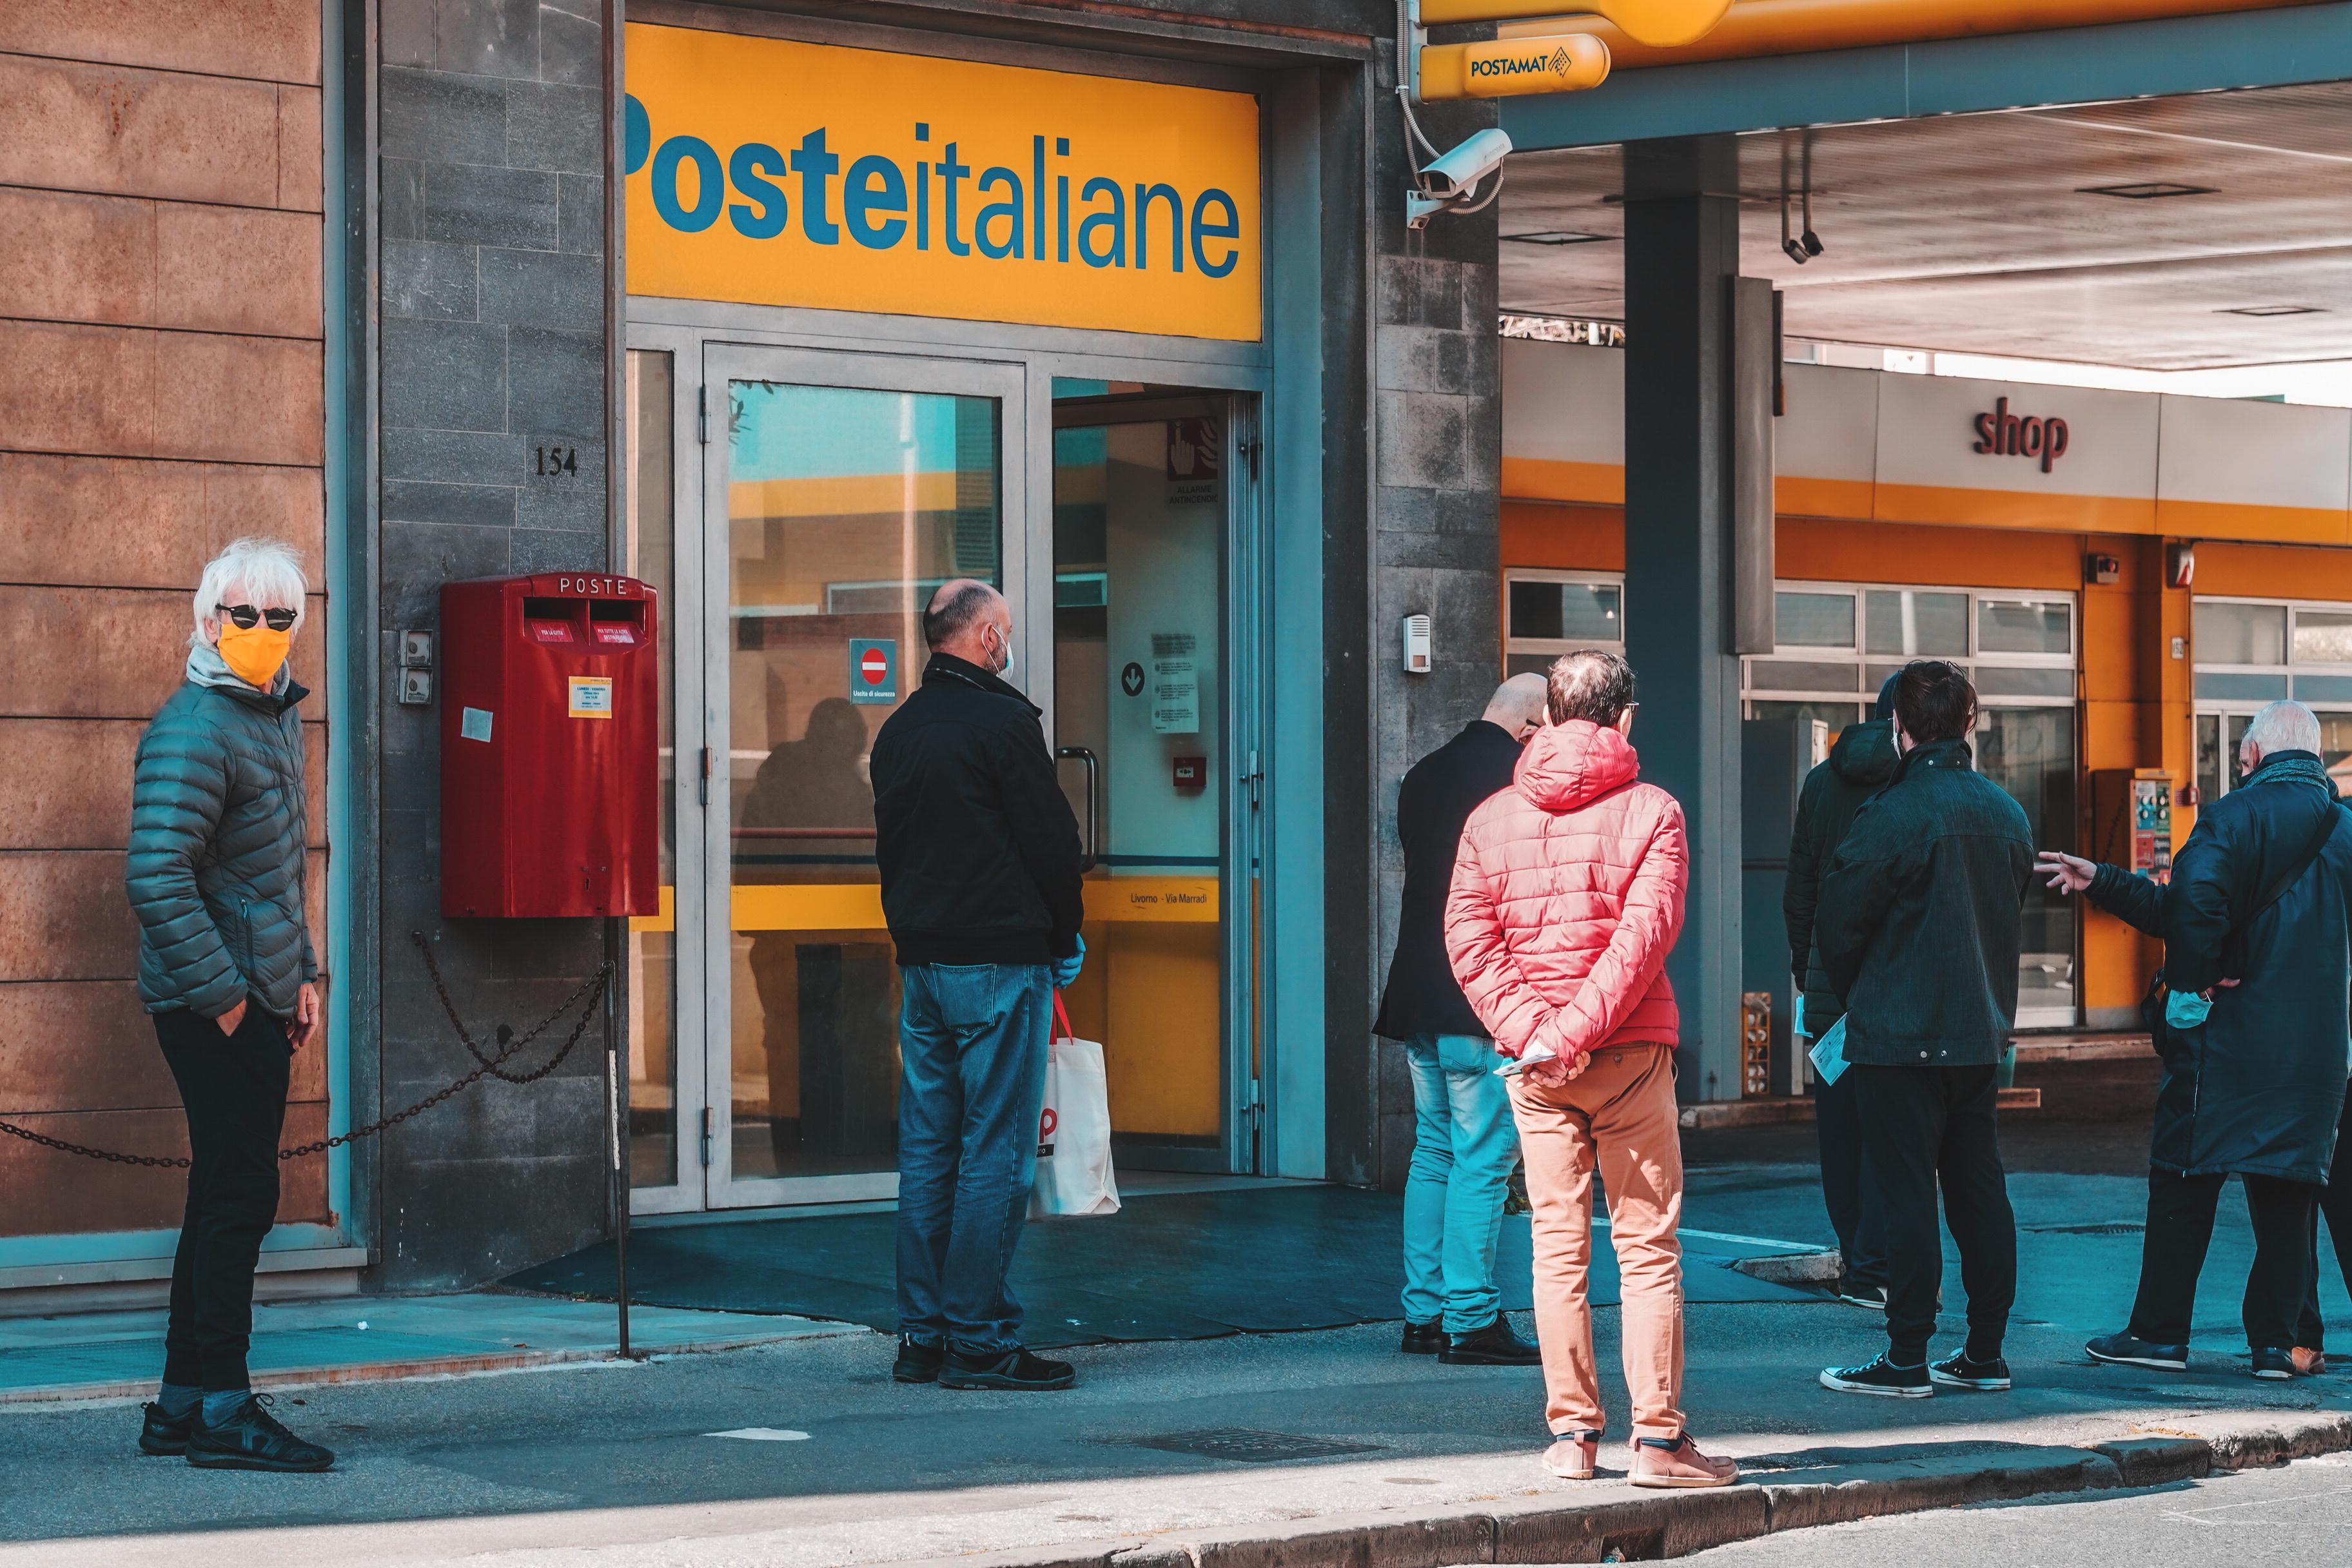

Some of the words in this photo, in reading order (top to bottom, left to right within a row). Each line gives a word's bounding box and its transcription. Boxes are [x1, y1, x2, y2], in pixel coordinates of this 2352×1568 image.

[1471, 55, 1548, 77] POSTAMAT
[1973, 397, 2069, 474] shop
[536, 446, 577, 477] 154
[1177, 485, 1212, 495] ALLARME
[560, 578, 627, 595] POSTE
[1131, 894, 1158, 903] Livorno
[1166, 894, 1177, 903] Via
[1179, 894, 1207, 903] Marradi
